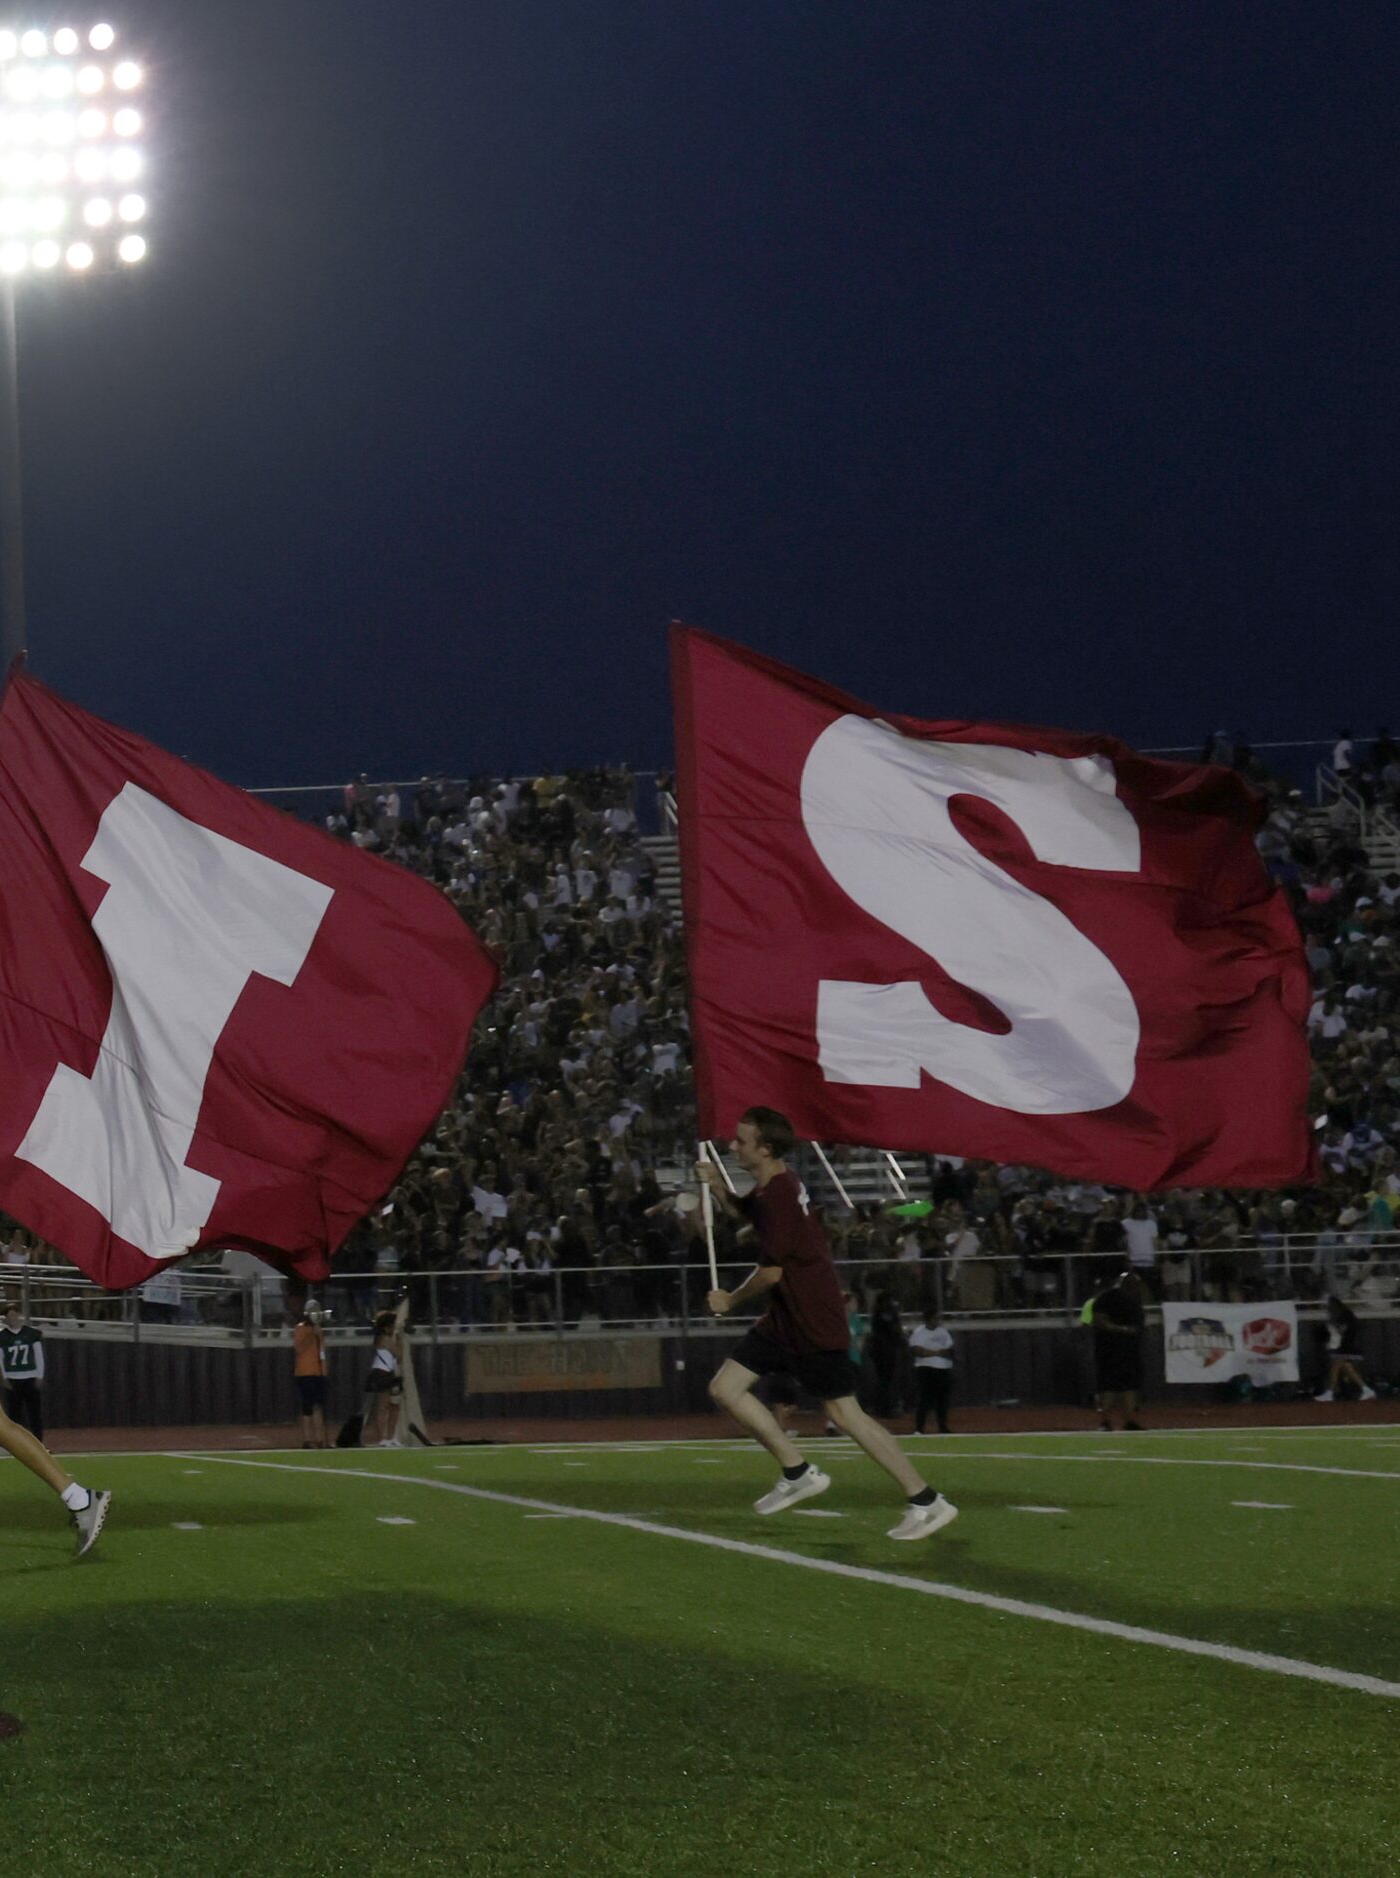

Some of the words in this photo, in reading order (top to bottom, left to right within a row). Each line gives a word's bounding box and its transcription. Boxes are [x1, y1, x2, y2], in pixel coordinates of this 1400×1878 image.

[14, 780, 335, 1261] I
[800, 713, 1141, 1115] S
[7, 1344, 30, 1367] 77
